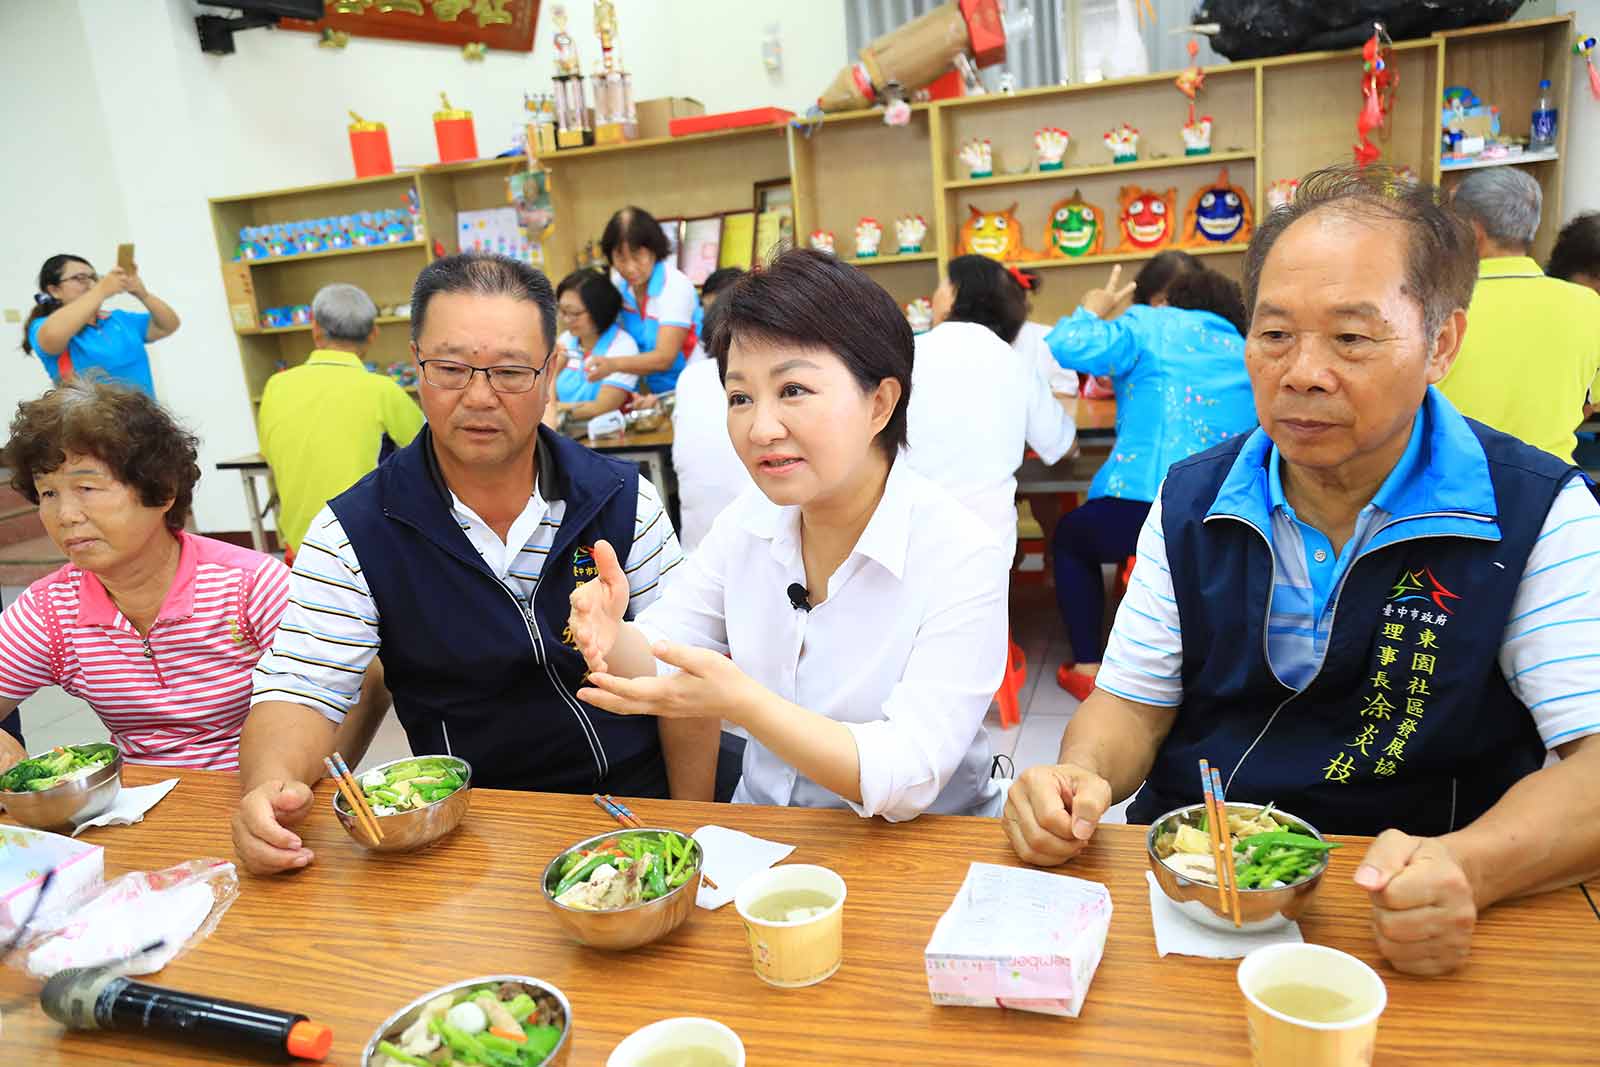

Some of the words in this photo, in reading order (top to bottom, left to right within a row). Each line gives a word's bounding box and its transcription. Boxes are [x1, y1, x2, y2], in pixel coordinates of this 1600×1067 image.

[1382, 603, 1448, 626] 臺中市政府
